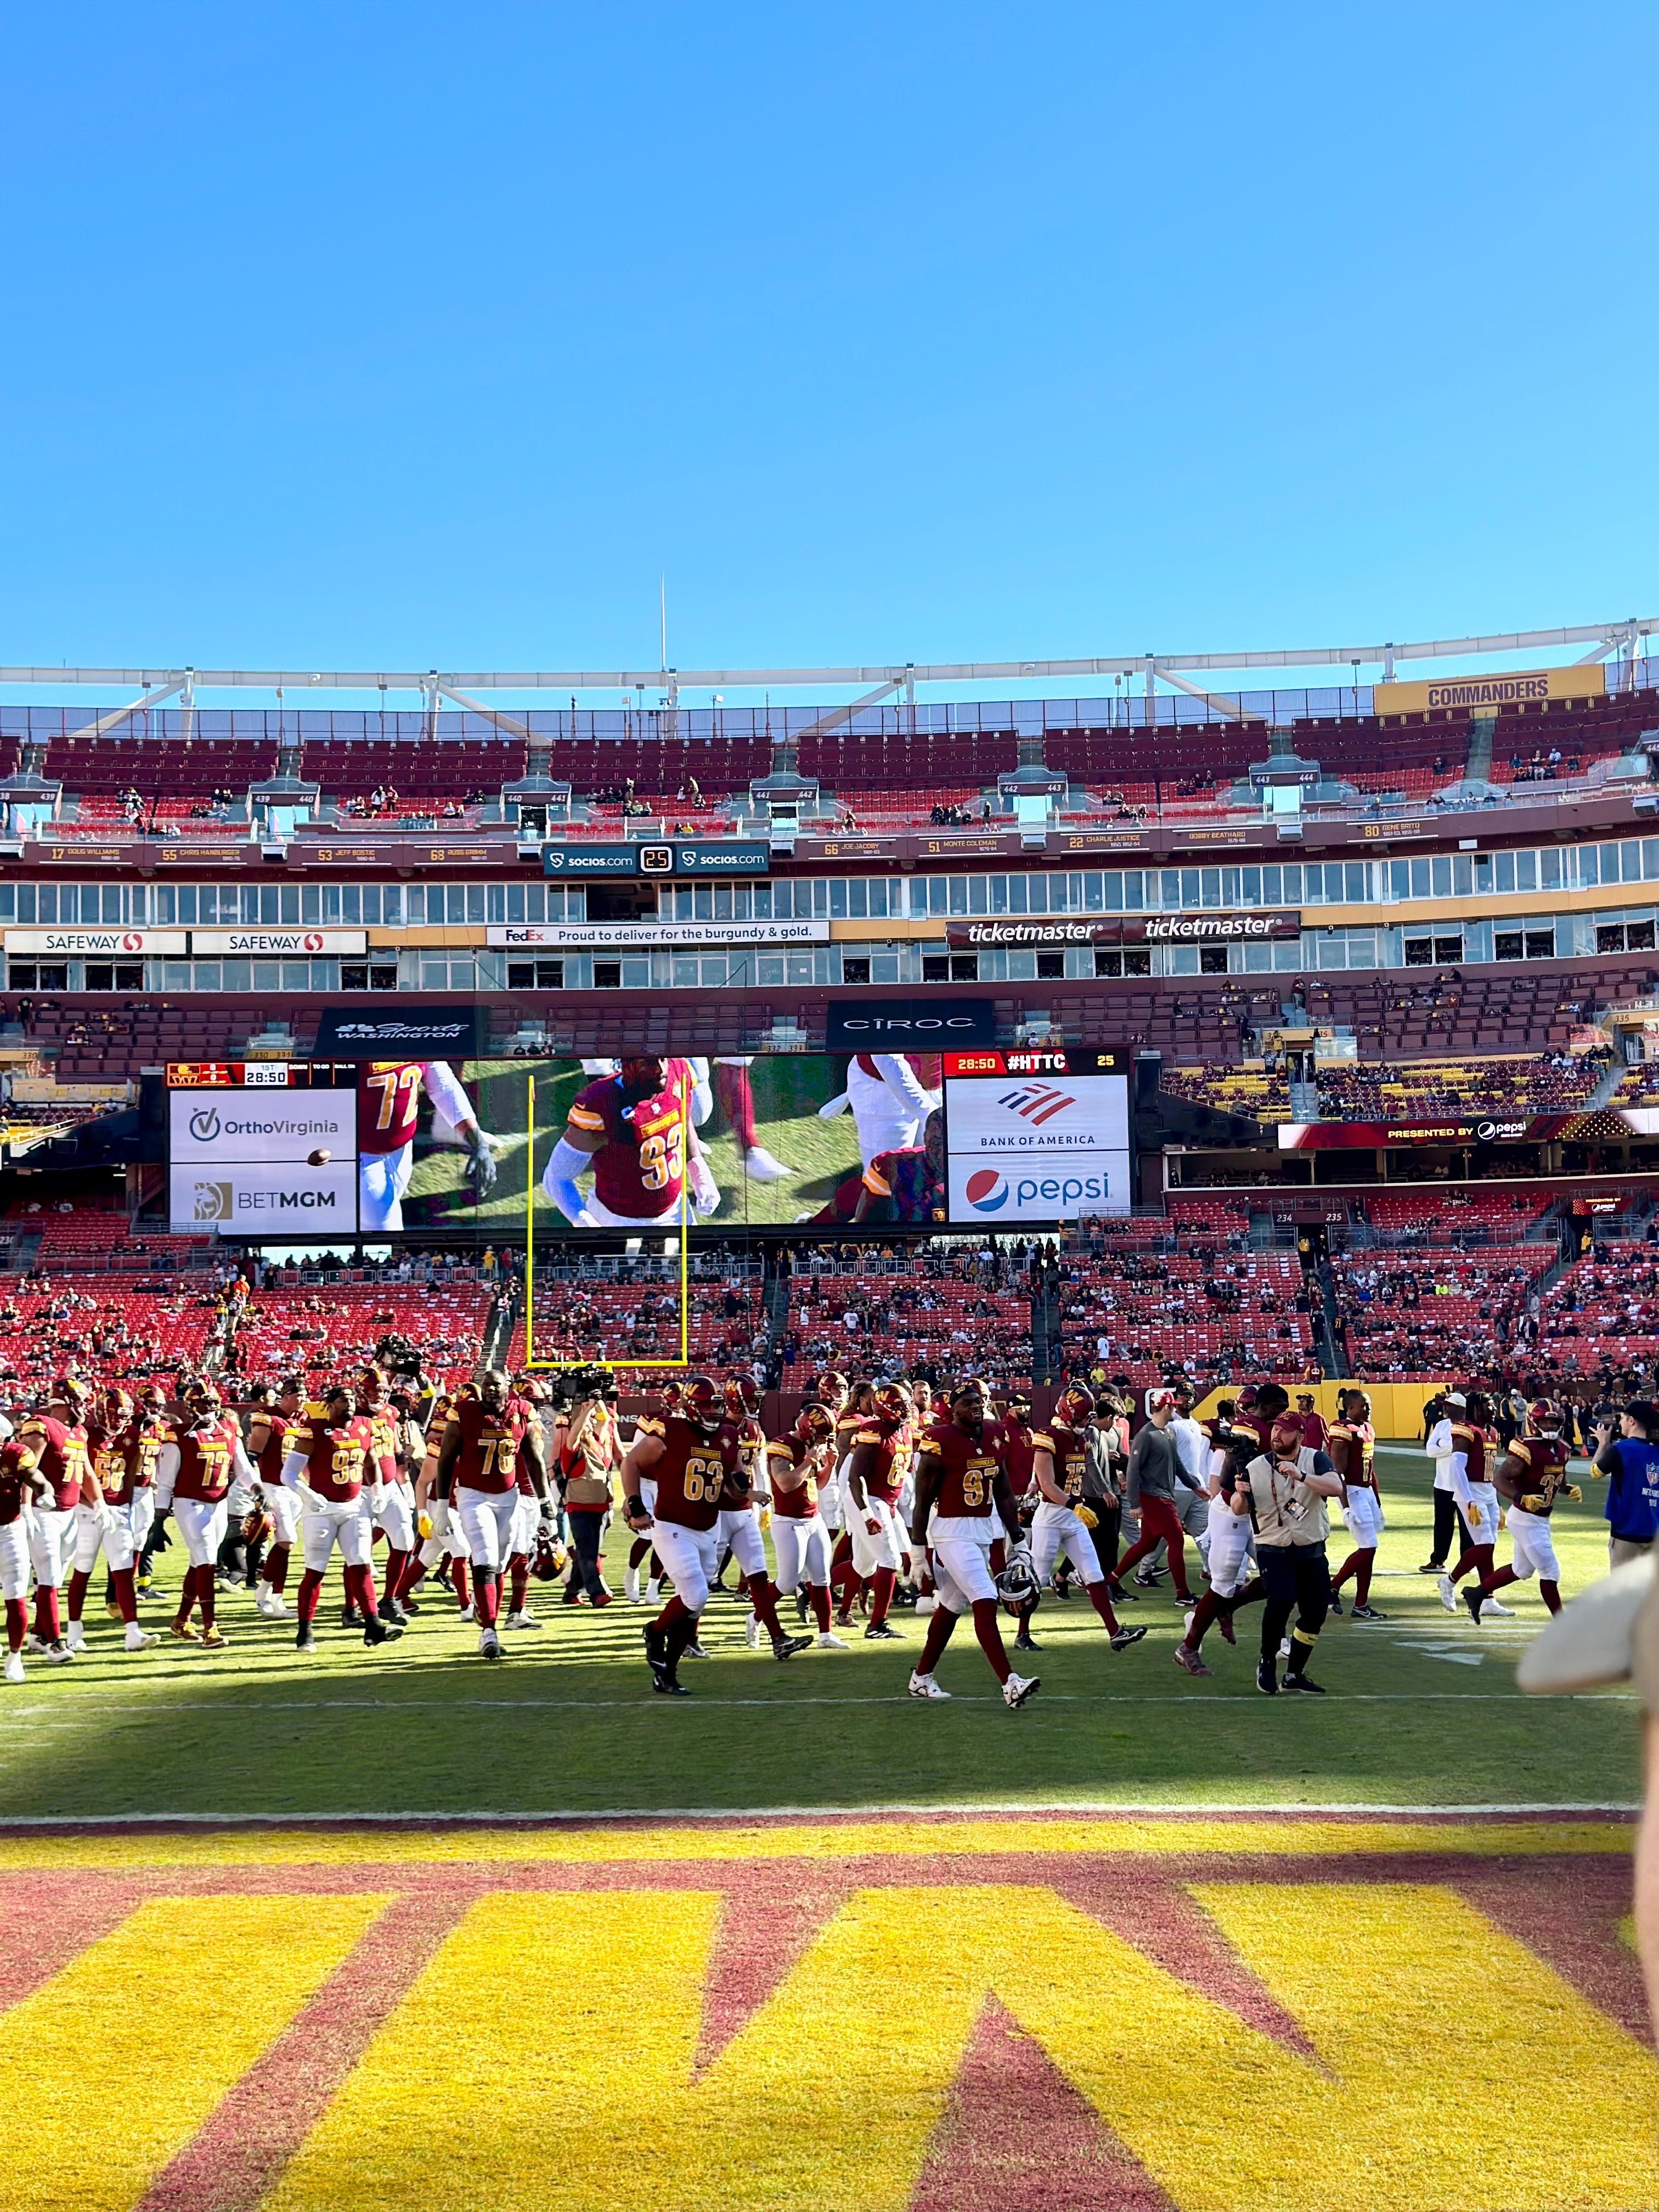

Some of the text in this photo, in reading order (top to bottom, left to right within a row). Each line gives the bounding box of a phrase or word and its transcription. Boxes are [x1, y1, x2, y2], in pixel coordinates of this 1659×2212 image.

[1428, 679, 1548, 708] COMMANDERS
[507, 794, 522, 803] 440
[1365, 826, 1379, 837] 80
[928, 841, 940, 853] 51
[1069, 837, 1084, 848] 22
[52, 849, 64, 860] 17
[162, 849, 177, 860] 55
[318, 850, 332, 861] 53
[431, 849, 444, 861] 68
[825, 844, 838, 855] 66
[568, 856, 633, 866] socios.com
[646, 851, 667, 866] 25
[700, 854, 764, 865] socios.com
[506, 929, 544, 941] FedEx
[558, 927, 812, 941] Proud to deliver for the burgundy & gold.
[46, 935, 120, 949] SAFEWAY
[229, 935, 301, 950] SAFEWAY
[376, 1023, 470, 1037] Sports
[958, 1058, 996, 1070] 28:50
[1007, 1054, 1065, 1070] #HTTC
[1097, 1055, 1114, 1066] 25
[247, 1073, 285, 1082] 28:50
[224, 1118, 338, 1135] OrthoVirginia
[1388, 1127, 1473, 1138] PRESENTED BY
[1497, 1121, 1526, 1134] pepsi
[981, 1135, 1095, 1146] BANK OF AMERICA
[1018, 1172, 1110, 1206] pepsi
[238, 1191, 335, 1208] BETMGM
[1277, 1214, 1292, 1222] 234
[332, 1449, 365, 1485] 93
[684, 1458, 724, 1503] 63
